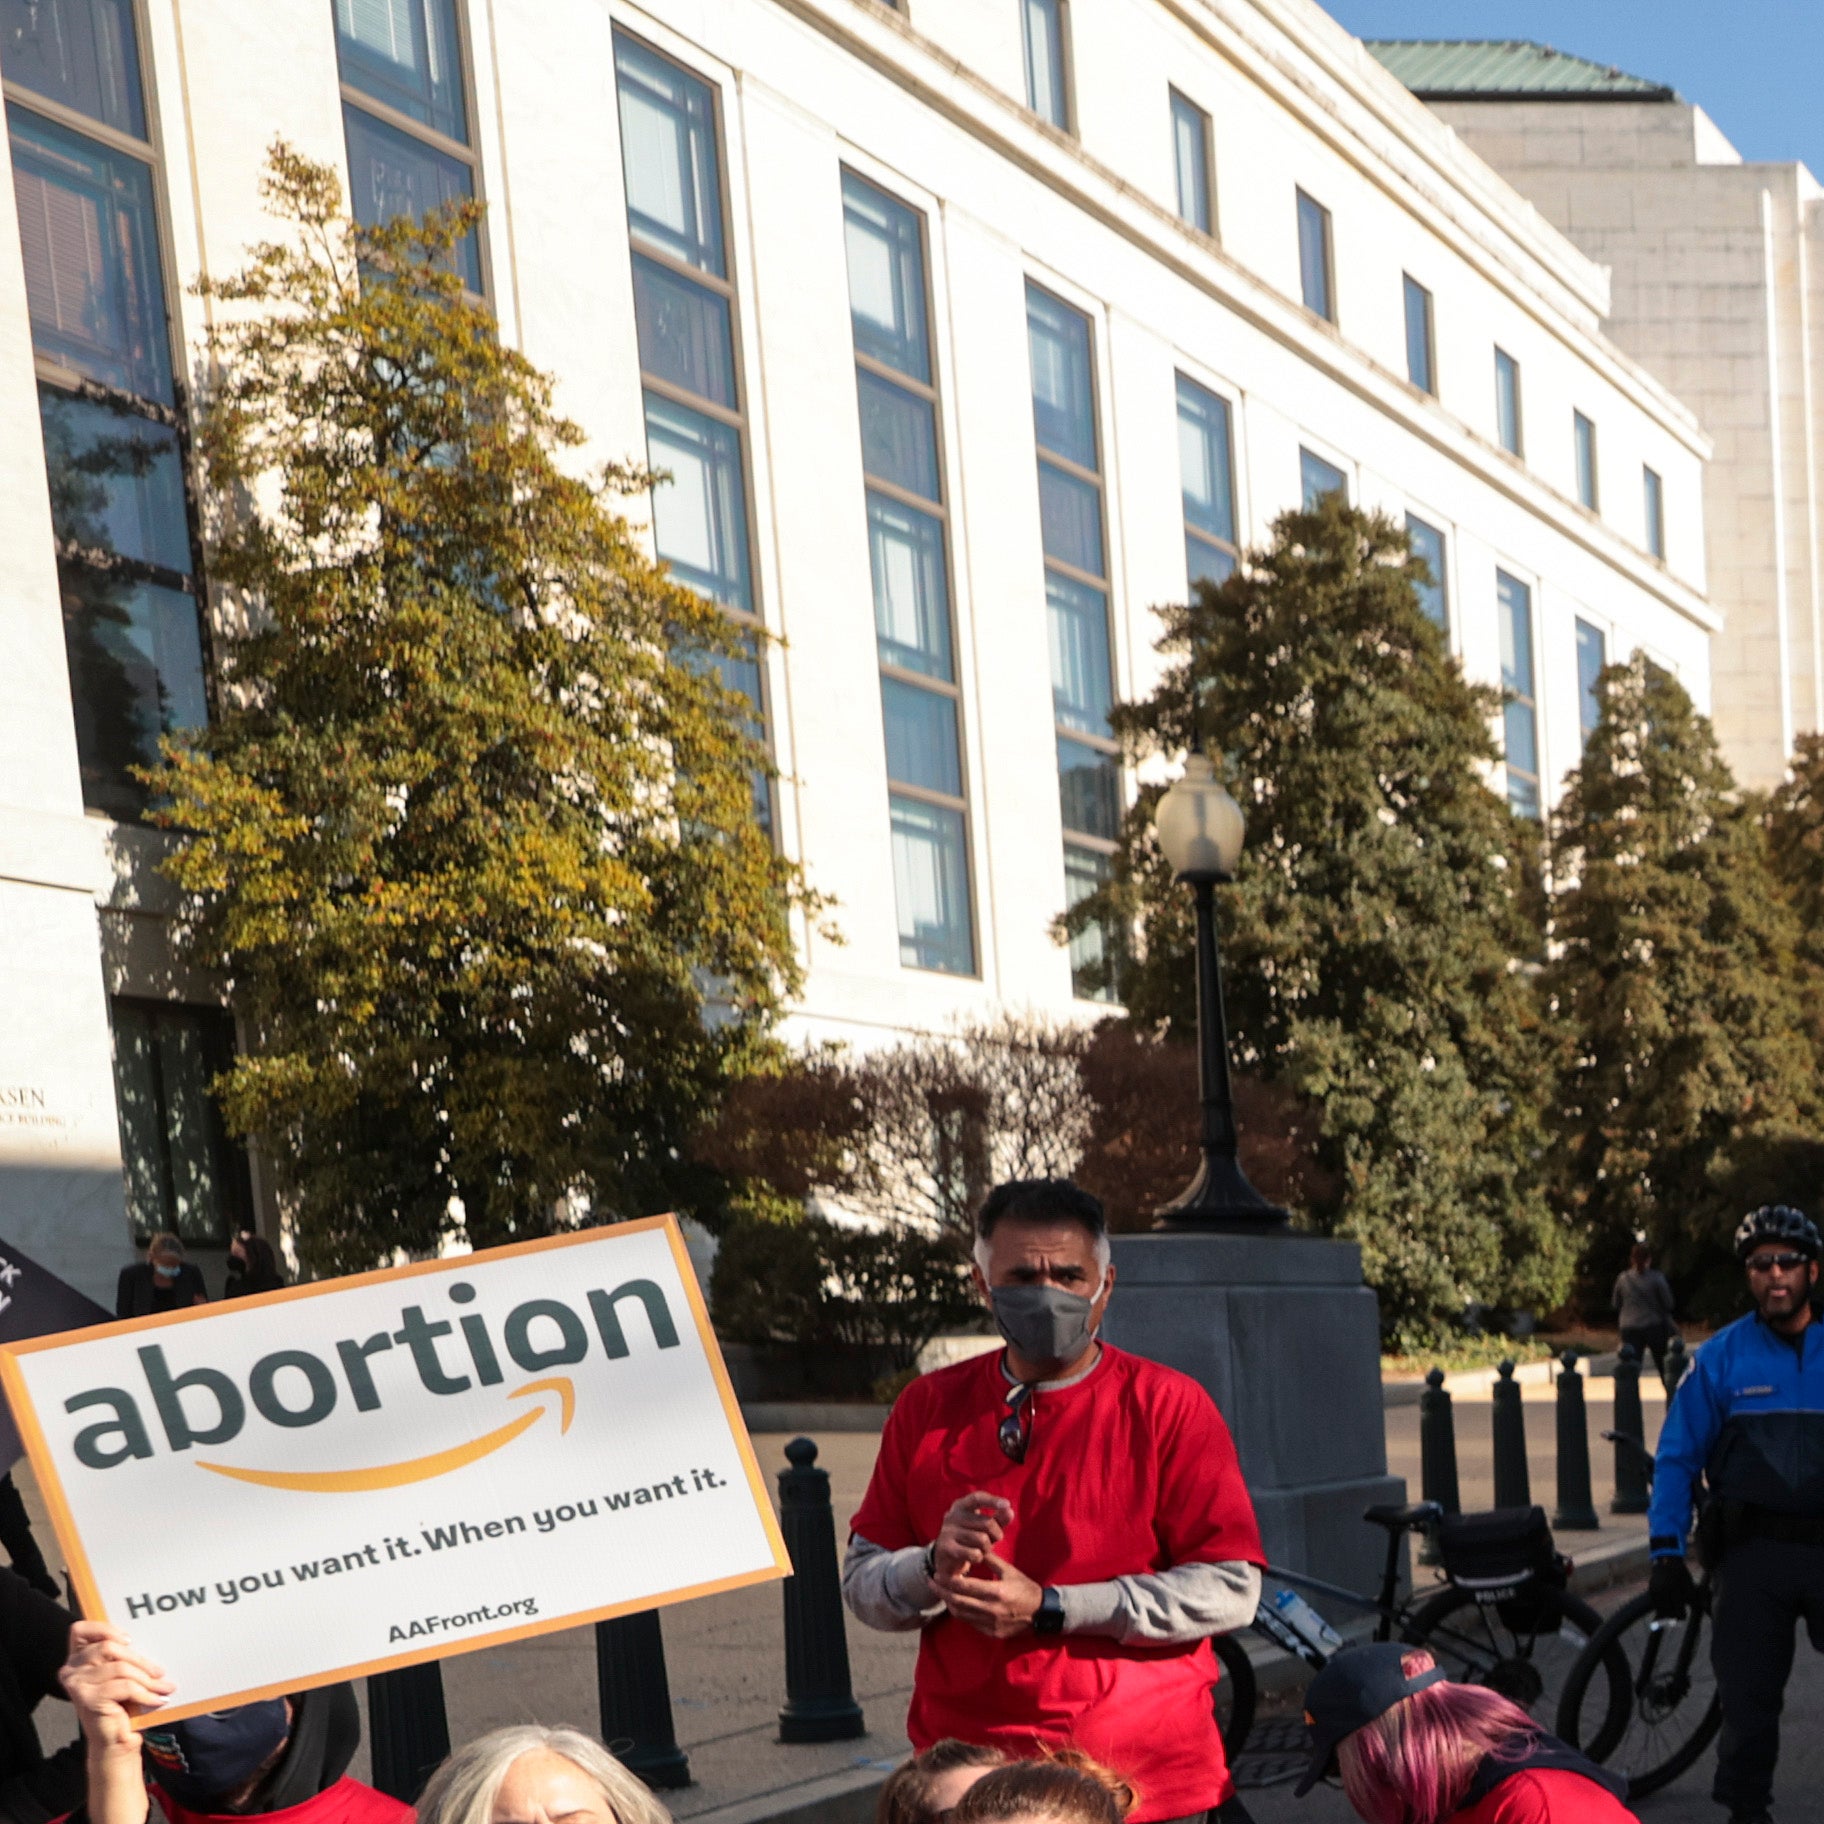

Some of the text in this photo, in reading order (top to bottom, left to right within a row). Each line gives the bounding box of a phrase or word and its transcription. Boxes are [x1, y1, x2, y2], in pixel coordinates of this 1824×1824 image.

[65, 1279, 681, 1469] abortion
[126, 1466, 728, 1620] How you want it. When you want it.
[388, 1596, 539, 1643] AAFront.org
[1475, 1588, 1516, 1601] POLICE
